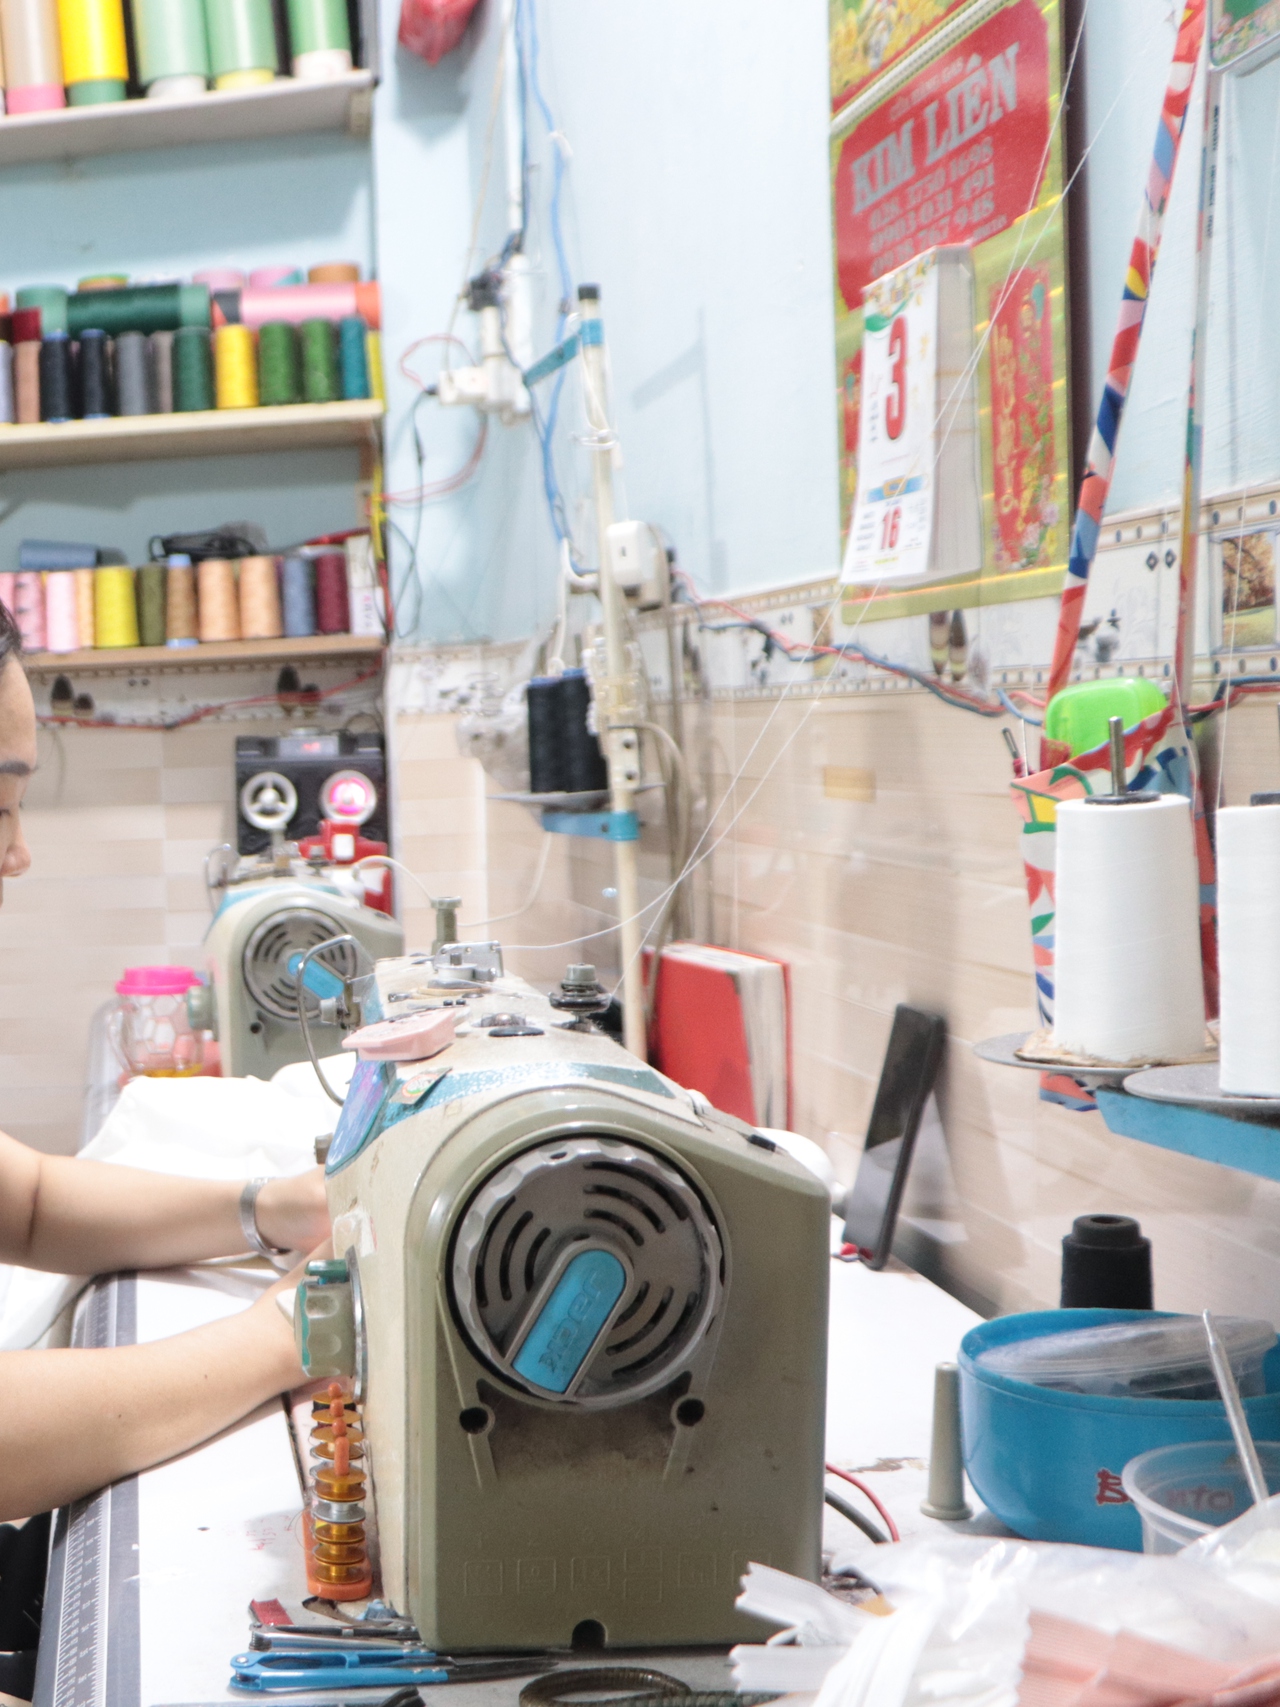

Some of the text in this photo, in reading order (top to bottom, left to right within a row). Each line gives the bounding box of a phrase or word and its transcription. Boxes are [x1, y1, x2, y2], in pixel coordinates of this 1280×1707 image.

[851, 41, 1019, 215] KIM LIÊN
[960, 162, 995, 200] 491
[885, 314, 908, 441] 3
[881, 505, 902, 550] 16
